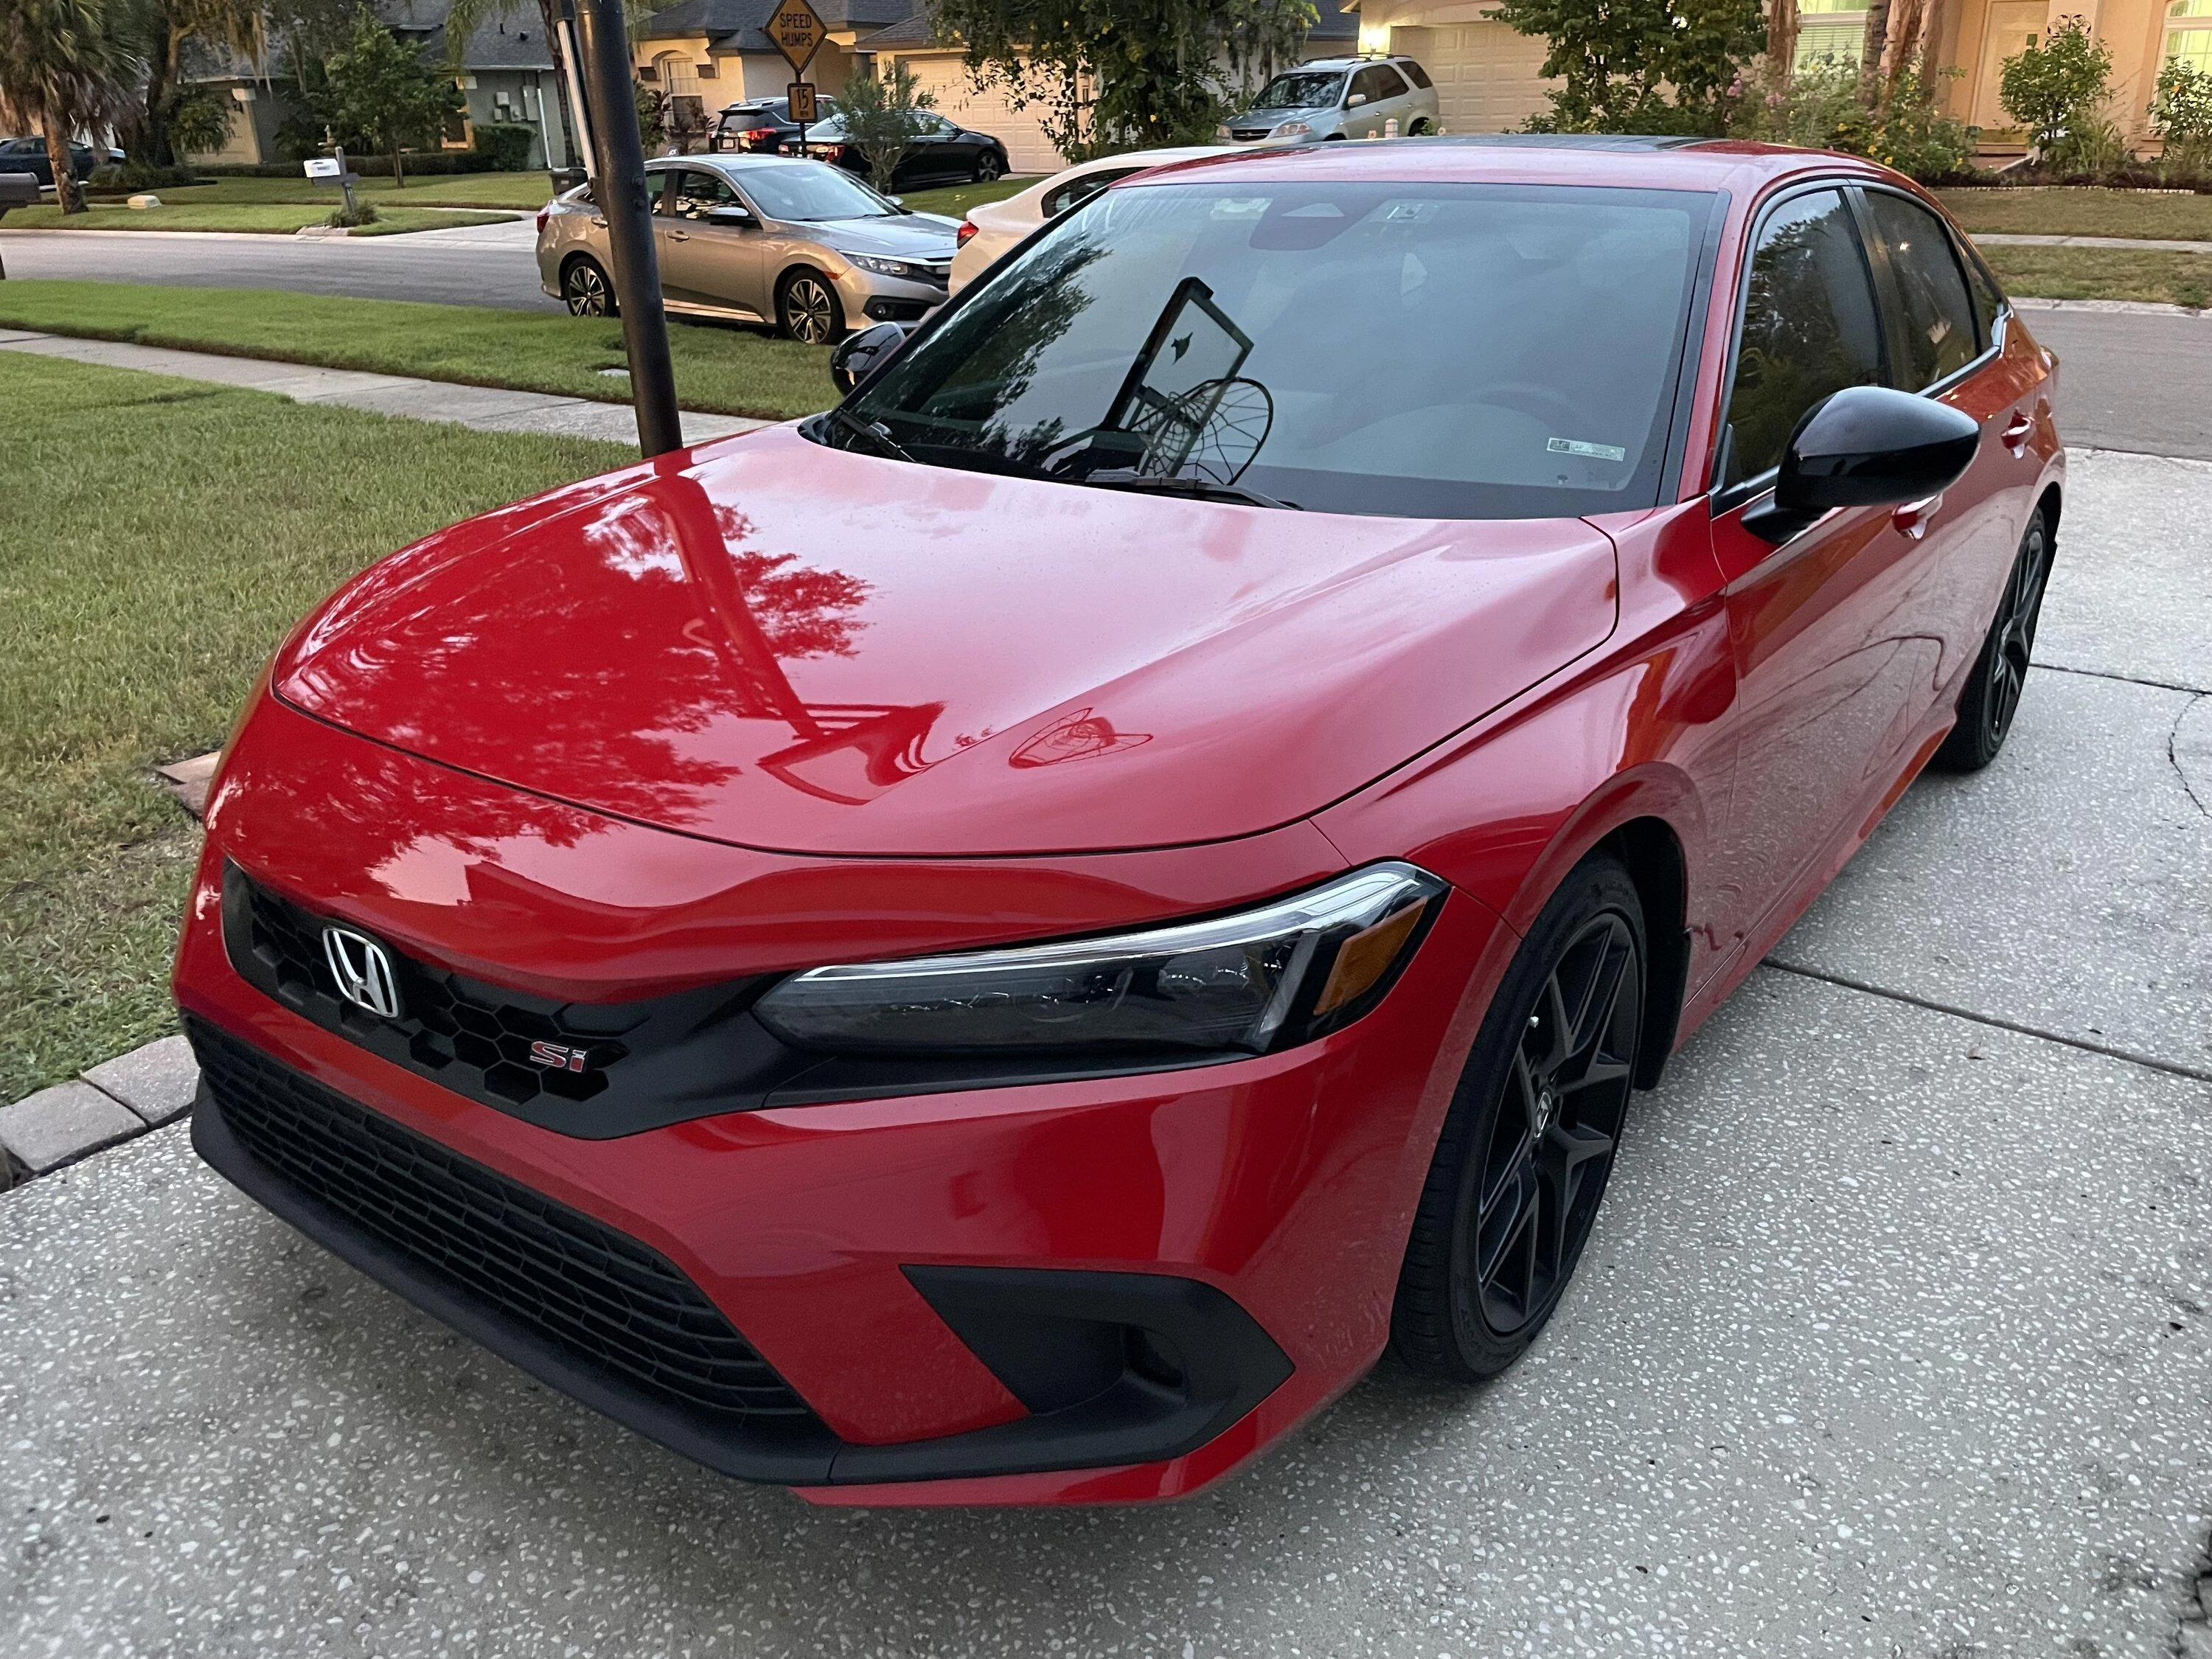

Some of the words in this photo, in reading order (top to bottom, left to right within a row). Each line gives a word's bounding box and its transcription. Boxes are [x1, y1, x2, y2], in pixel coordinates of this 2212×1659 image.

[779, 13, 812, 28] SPEED
[781, 32, 813, 46] HUMPS
[796, 88, 809, 109] 15
[529, 1041, 587, 1073] Si
